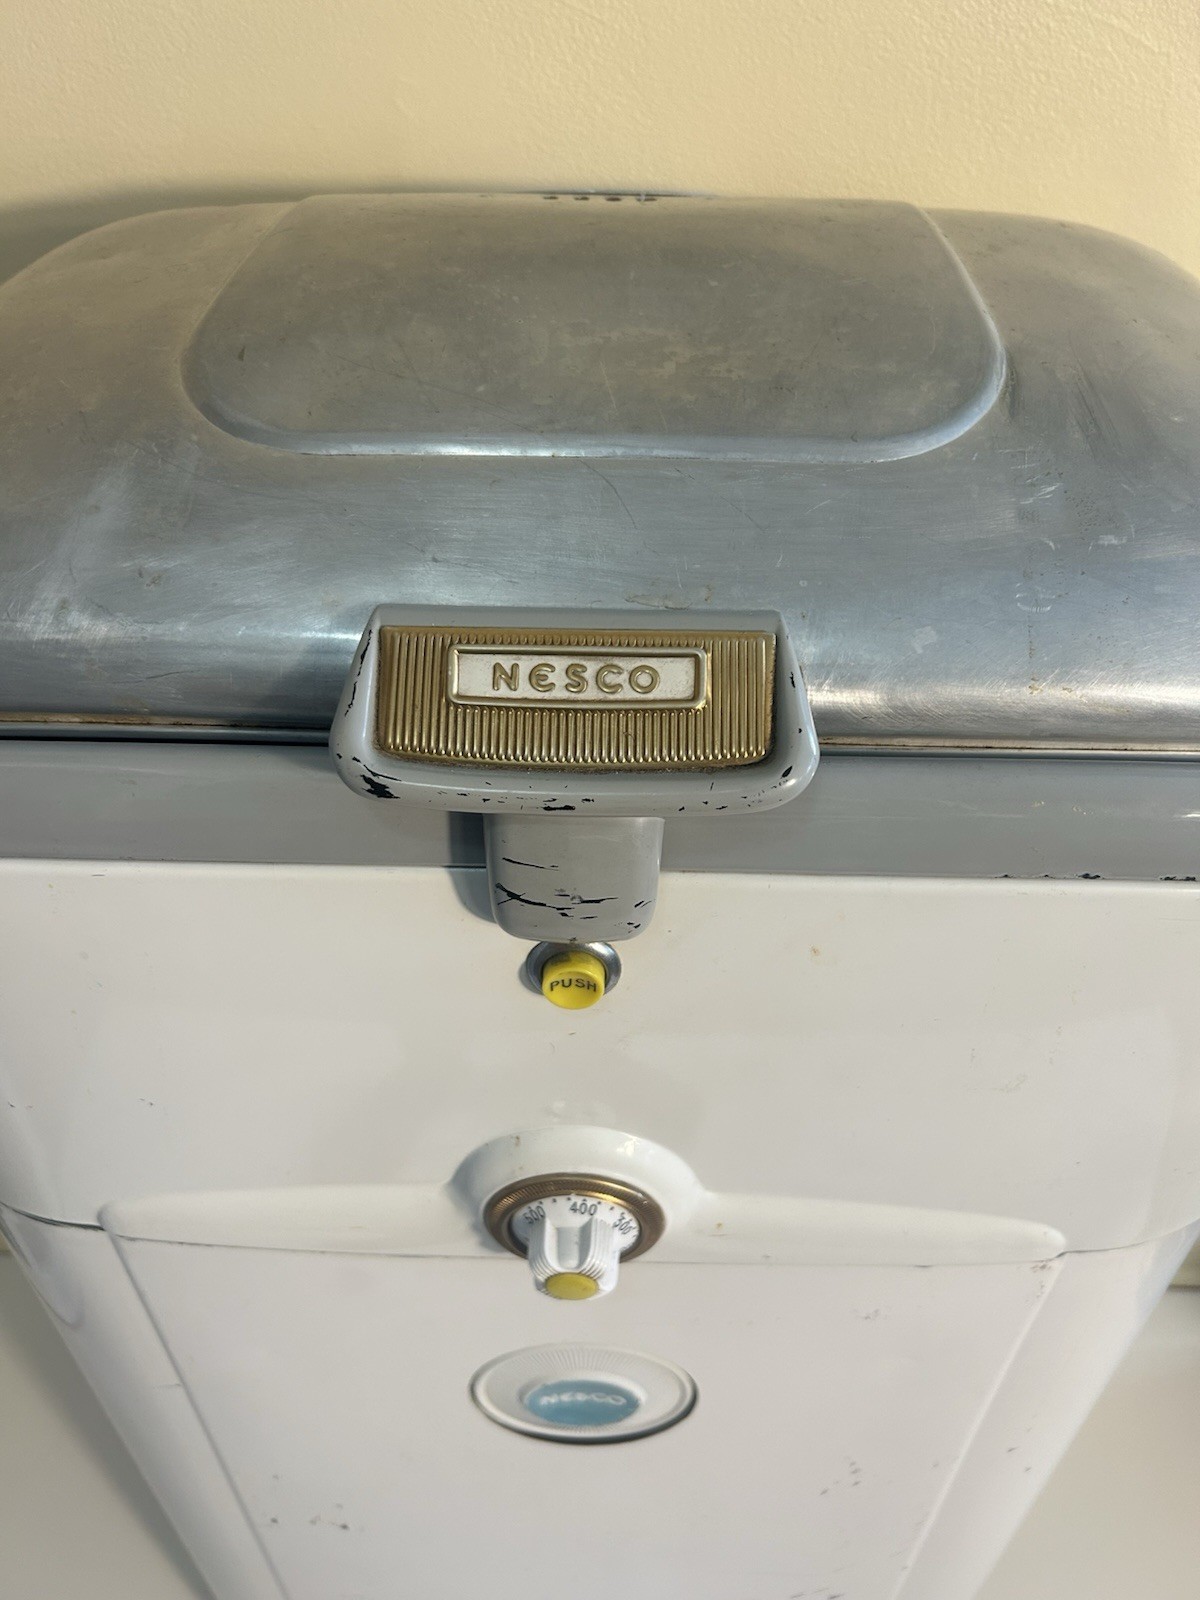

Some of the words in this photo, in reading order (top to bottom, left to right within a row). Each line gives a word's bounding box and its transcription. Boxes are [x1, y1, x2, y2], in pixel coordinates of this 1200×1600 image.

[492, 662, 661, 694] NESCO
[550, 978, 597, 992] PUSH
[522, 1204, 546, 1225] 500
[569, 1201, 598, 1217] 400
[612, 1214, 633, 1235] 300
